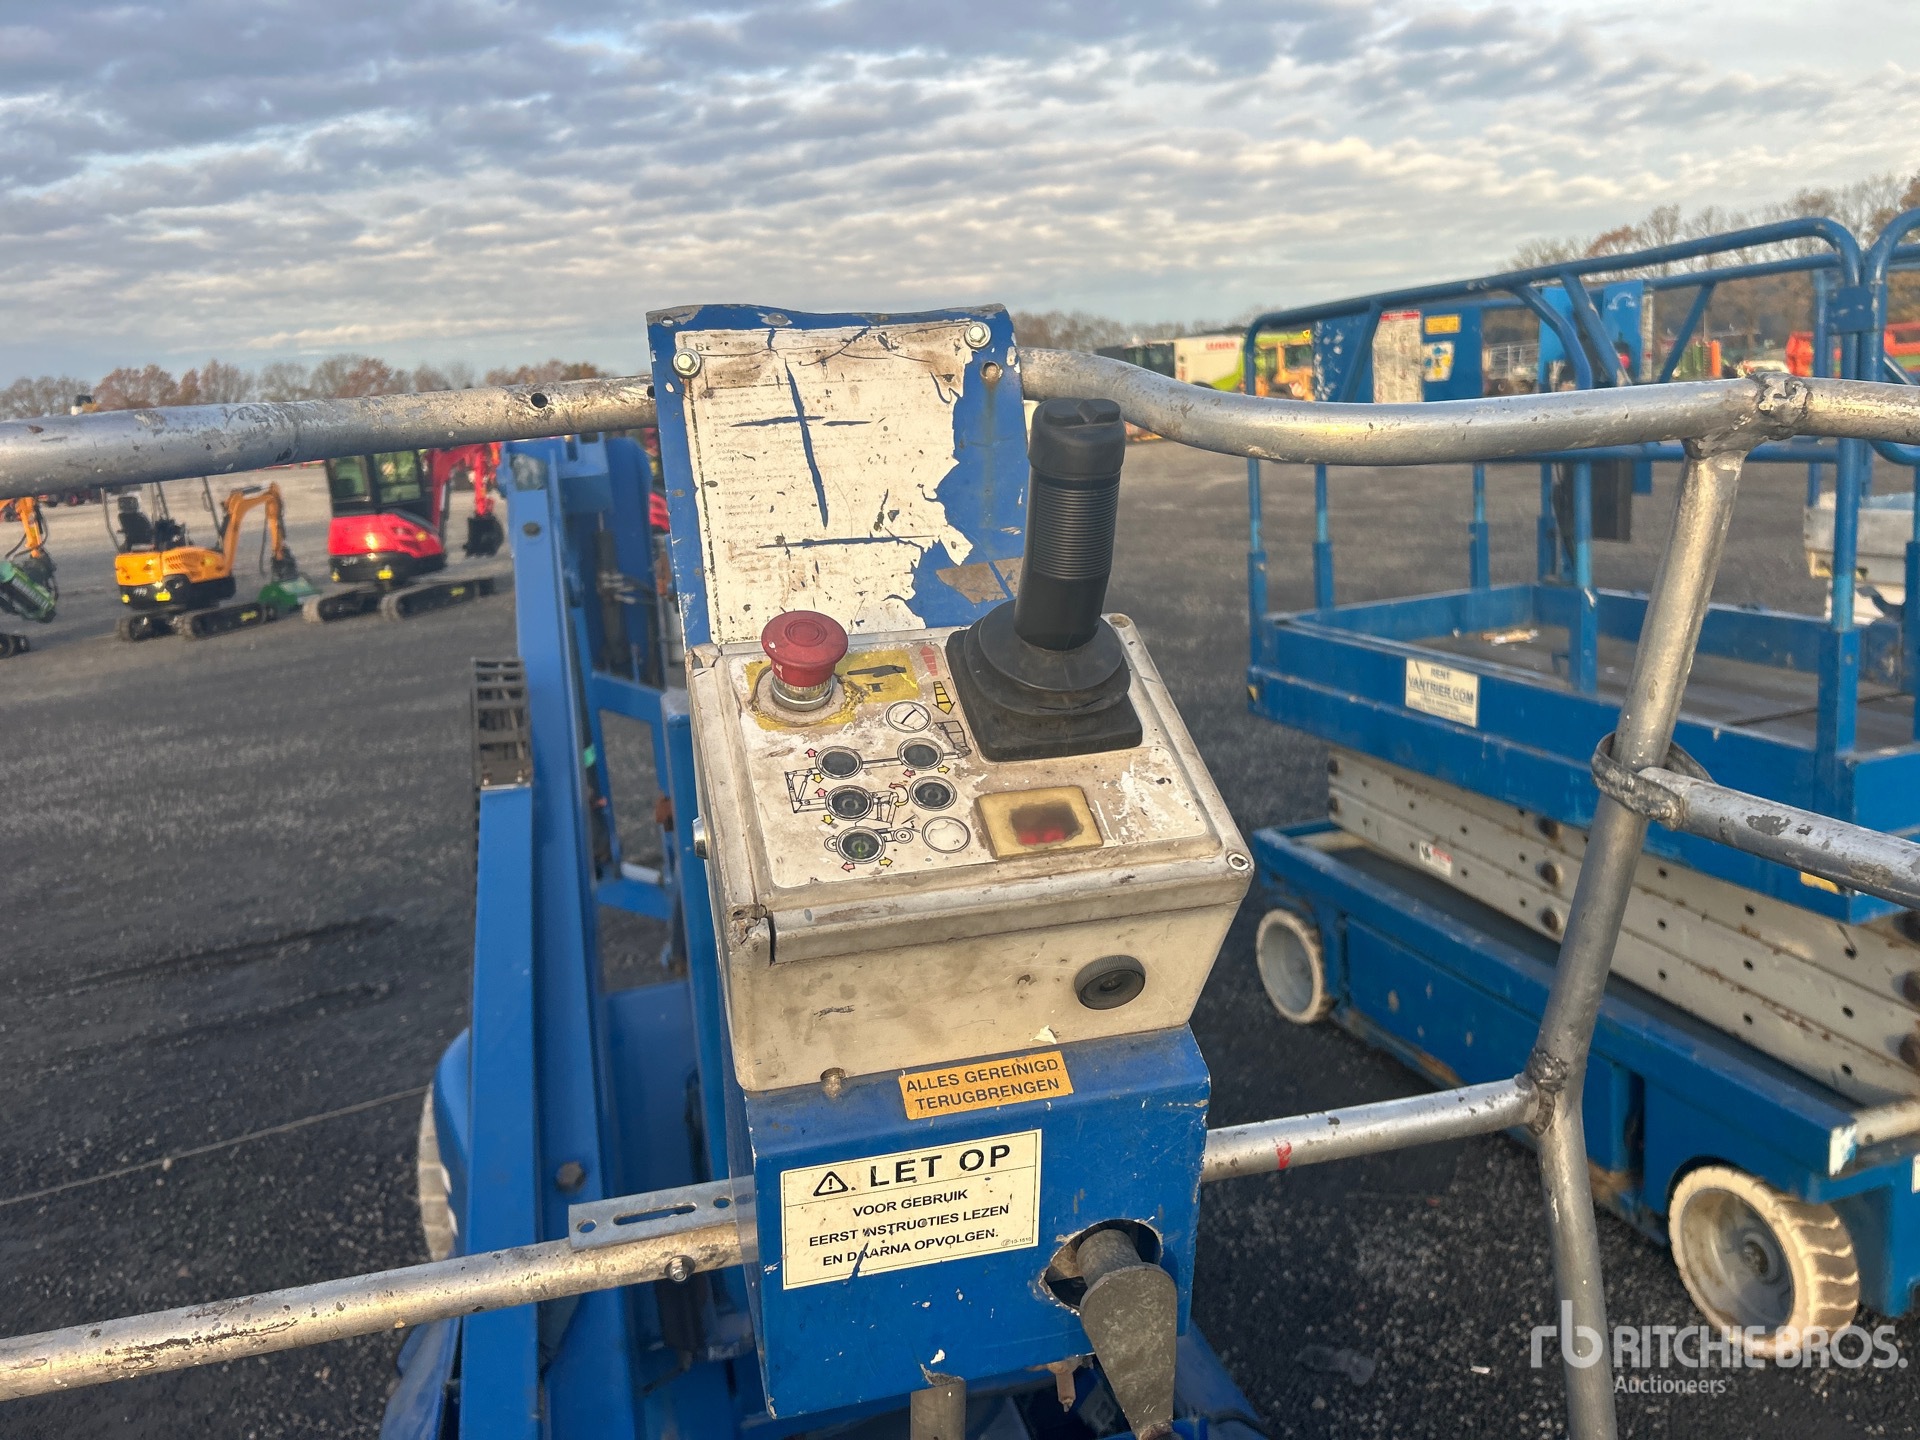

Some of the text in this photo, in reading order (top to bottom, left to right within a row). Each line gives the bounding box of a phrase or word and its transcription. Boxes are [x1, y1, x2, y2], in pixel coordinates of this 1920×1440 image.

[1431, 667, 1450, 679] RENT
[1408, 676, 1474, 704] VANTRIER.COM
[906, 1059, 1059, 1093] ALLES GEREINIGD
[915, 1078, 1060, 1110] TERUGBRENGEN
[870, 1144, 1010, 1187] LET OP
[853, 1189, 968, 1217] VOOR GEBRUIK
[809, 1229, 858, 1247] EERST
[963, 1204, 1010, 1221] LEZEN
[823, 1253, 843, 1266] EN
[914, 1228, 999, 1250] OPVOLGEN.
